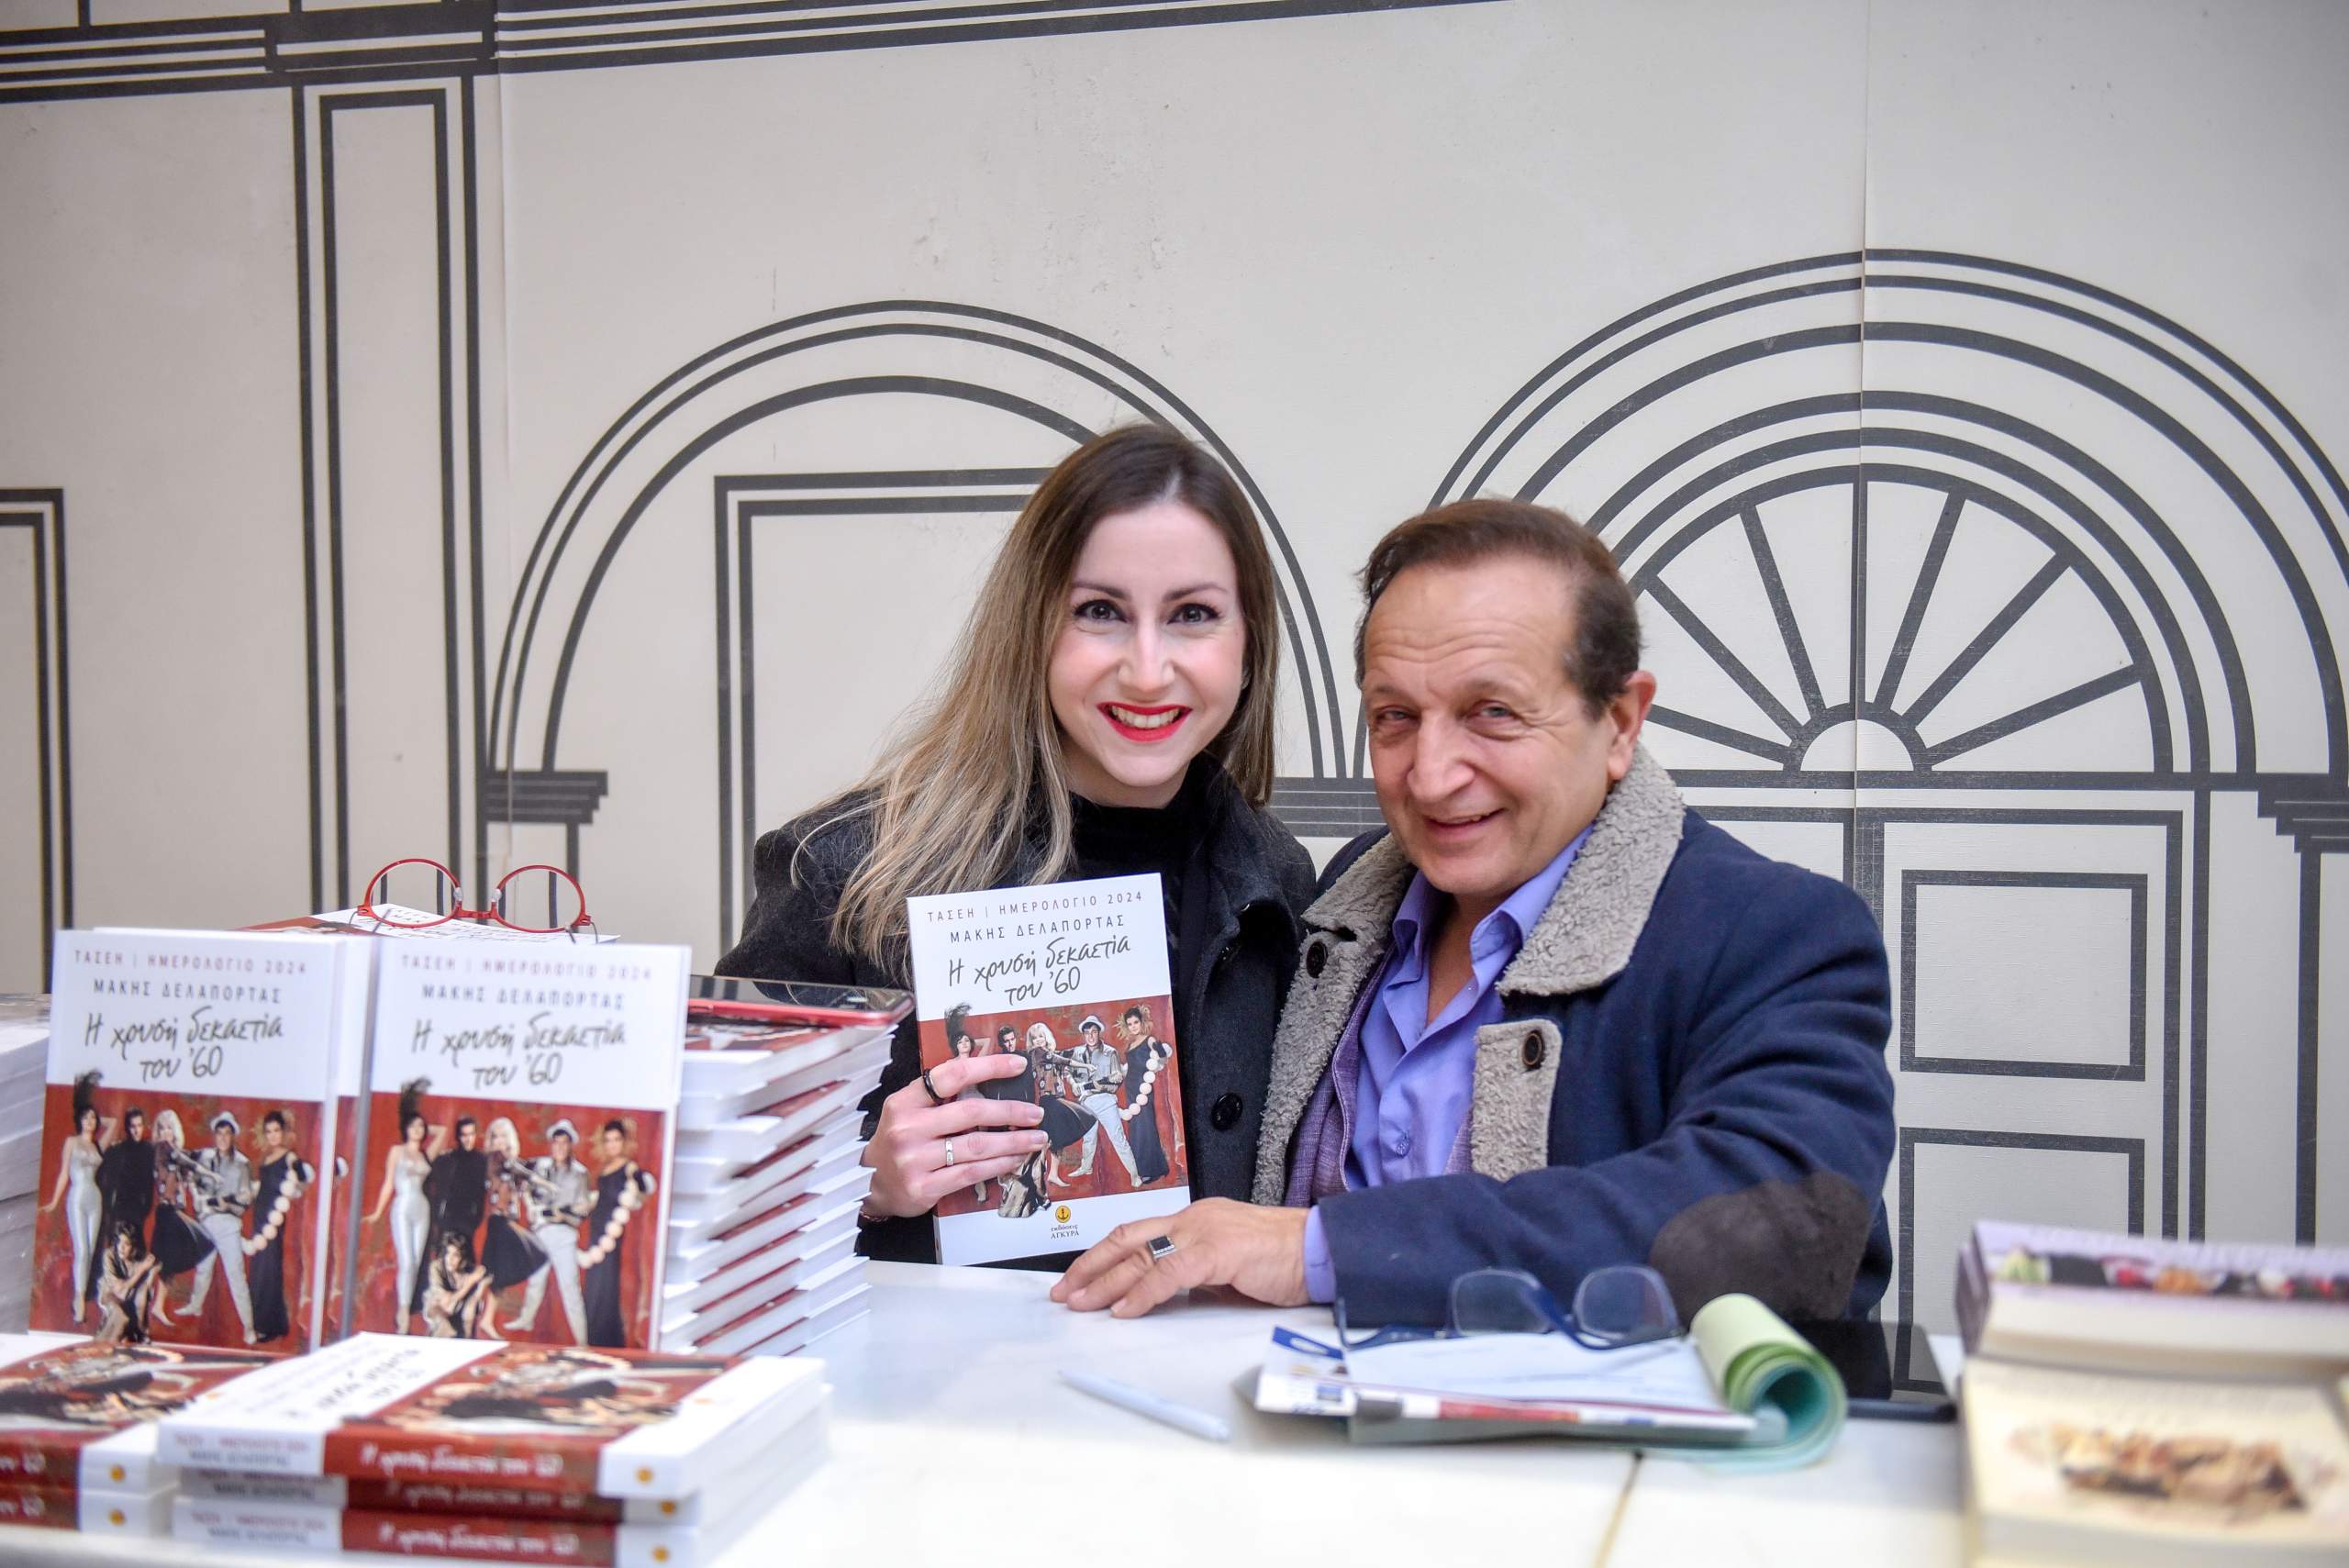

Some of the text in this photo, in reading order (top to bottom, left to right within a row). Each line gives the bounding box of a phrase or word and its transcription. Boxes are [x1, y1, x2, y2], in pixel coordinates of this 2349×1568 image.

[999, 895, 1097, 915] ΗΜΕΡΟΛΟΓΙΟ
[1108, 891, 1142, 905] 2024
[951, 915, 1125, 943] ΜΑΚΗΣ ΔΕΛΑΠΟΡΤΑΣ
[148, 955, 254, 973] ΗΜΕΡΟΛΟΓΙΟ
[265, 962, 306, 974] 2024
[974, 951, 1036, 991] χρυσή
[1046, 937, 1130, 969] δεκαετία
[94, 979, 281, 1004] ΜΑΚΗΣ ΔΕΛΑΠΟΡΤΑΣ
[1005, 981, 1043, 1006] του
[186, 1006, 284, 1044] δεκαετία
